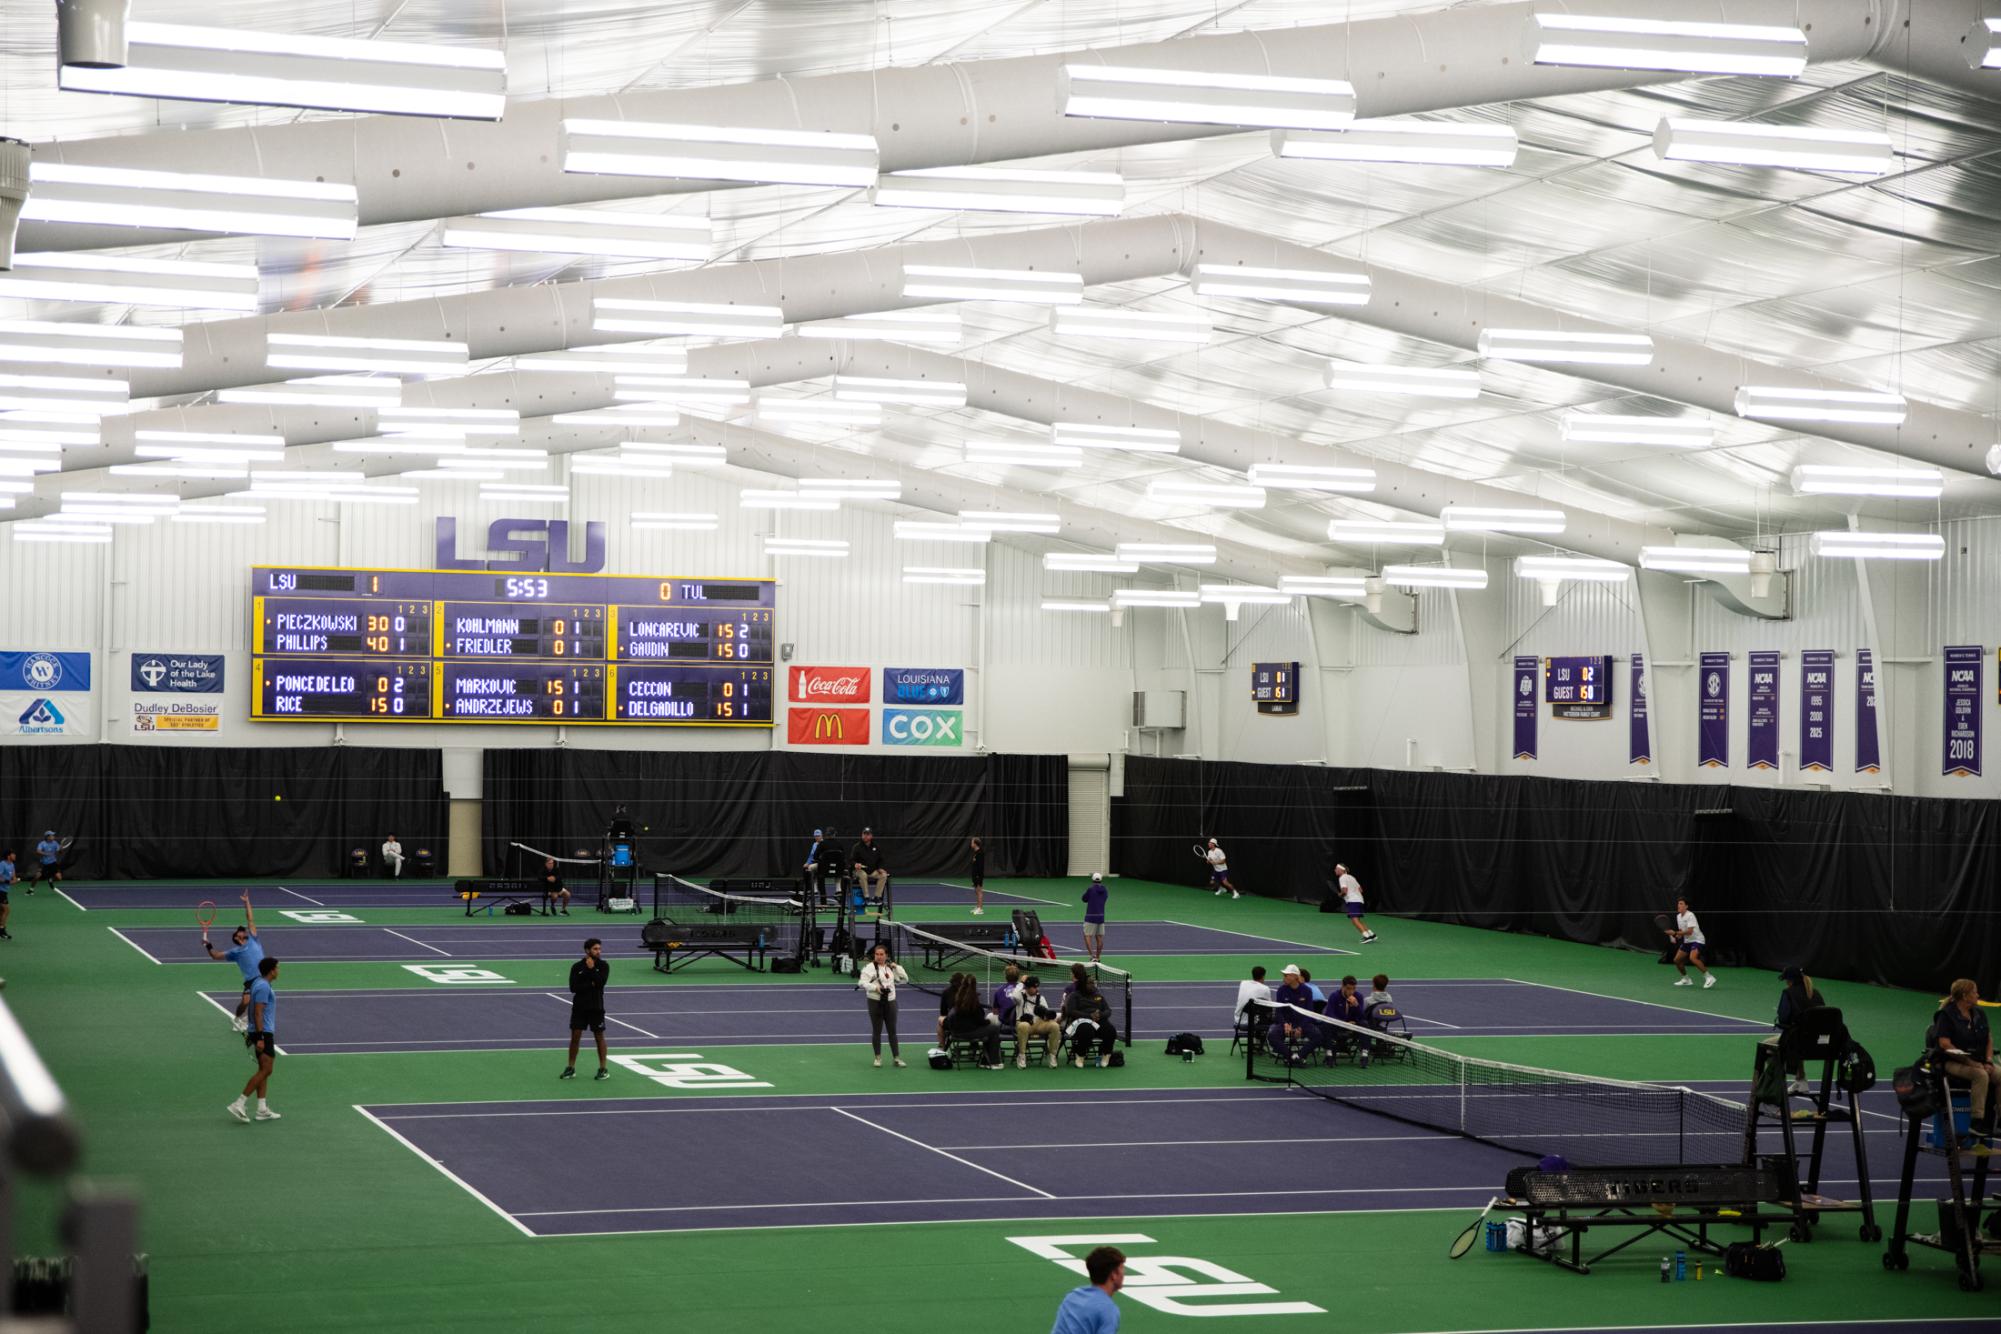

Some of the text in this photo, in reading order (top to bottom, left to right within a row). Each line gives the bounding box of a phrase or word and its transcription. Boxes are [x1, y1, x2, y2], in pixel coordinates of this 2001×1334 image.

[436, 516, 606, 573] LSU
[269, 573, 379, 593] LSU 1
[506, 577, 549, 598] 5:53
[660, 582, 707, 600] 0 TUL
[398, 605, 428, 614] 1 2 3
[573, 608, 601, 618] 1 2 3
[742, 613, 769, 621] 1 2 3
[276, 613, 405, 632] PIECZKOWSKI 30 0
[456, 618, 580, 635] KOHLMANN 0 1
[630, 621, 749, 639] LONCAREVIC 15 2
[276, 634, 405, 652] PHILLIPS 40 1
[456, 638, 579, 655] FRIEDLER 0 1
[630, 641, 748, 658] GAUDIN 15 0
[170, 660, 208, 669] Our Lady
[397, 666, 426, 675] 1 2 3
[170, 669, 216, 678] of the Lake
[572, 668, 600, 677] 1 2 3
[752, 671, 757, 680] 2
[763, 672, 768, 680] 3
[897, 674, 950, 684] LOUISIANA
[1557, 668, 1570, 681] LSU
[1754, 673, 1773, 684] NCAA
[1807, 672, 1826, 683] NCAA
[1951, 670, 1974, 681] NCAA
[170, 679, 197, 687] Health
[377, 677, 389, 693] 0
[394, 677, 405, 693] 2
[455, 678, 579, 695] MARKOVIC 15 1
[629, 681, 748, 697] CECCON 0 1
[807, 677, 861, 695] Coca-Cola
[897, 684, 926, 698] BLUE
[1553, 686, 1574, 699] GUEST
[134, 703, 217, 714] Dudley DeBosier
[275, 696, 404, 713] RICE 15 0
[455, 698, 578, 715] ANDRZEJEWS 0 1
[629, 700, 748, 717] DELGADILLO 15 1
[19, 726, 64, 734] Albertsons
[889, 715, 956, 739] COX
[1950, 739, 1974, 759] 2018
[1379, 1008, 1396, 1016] LSU
